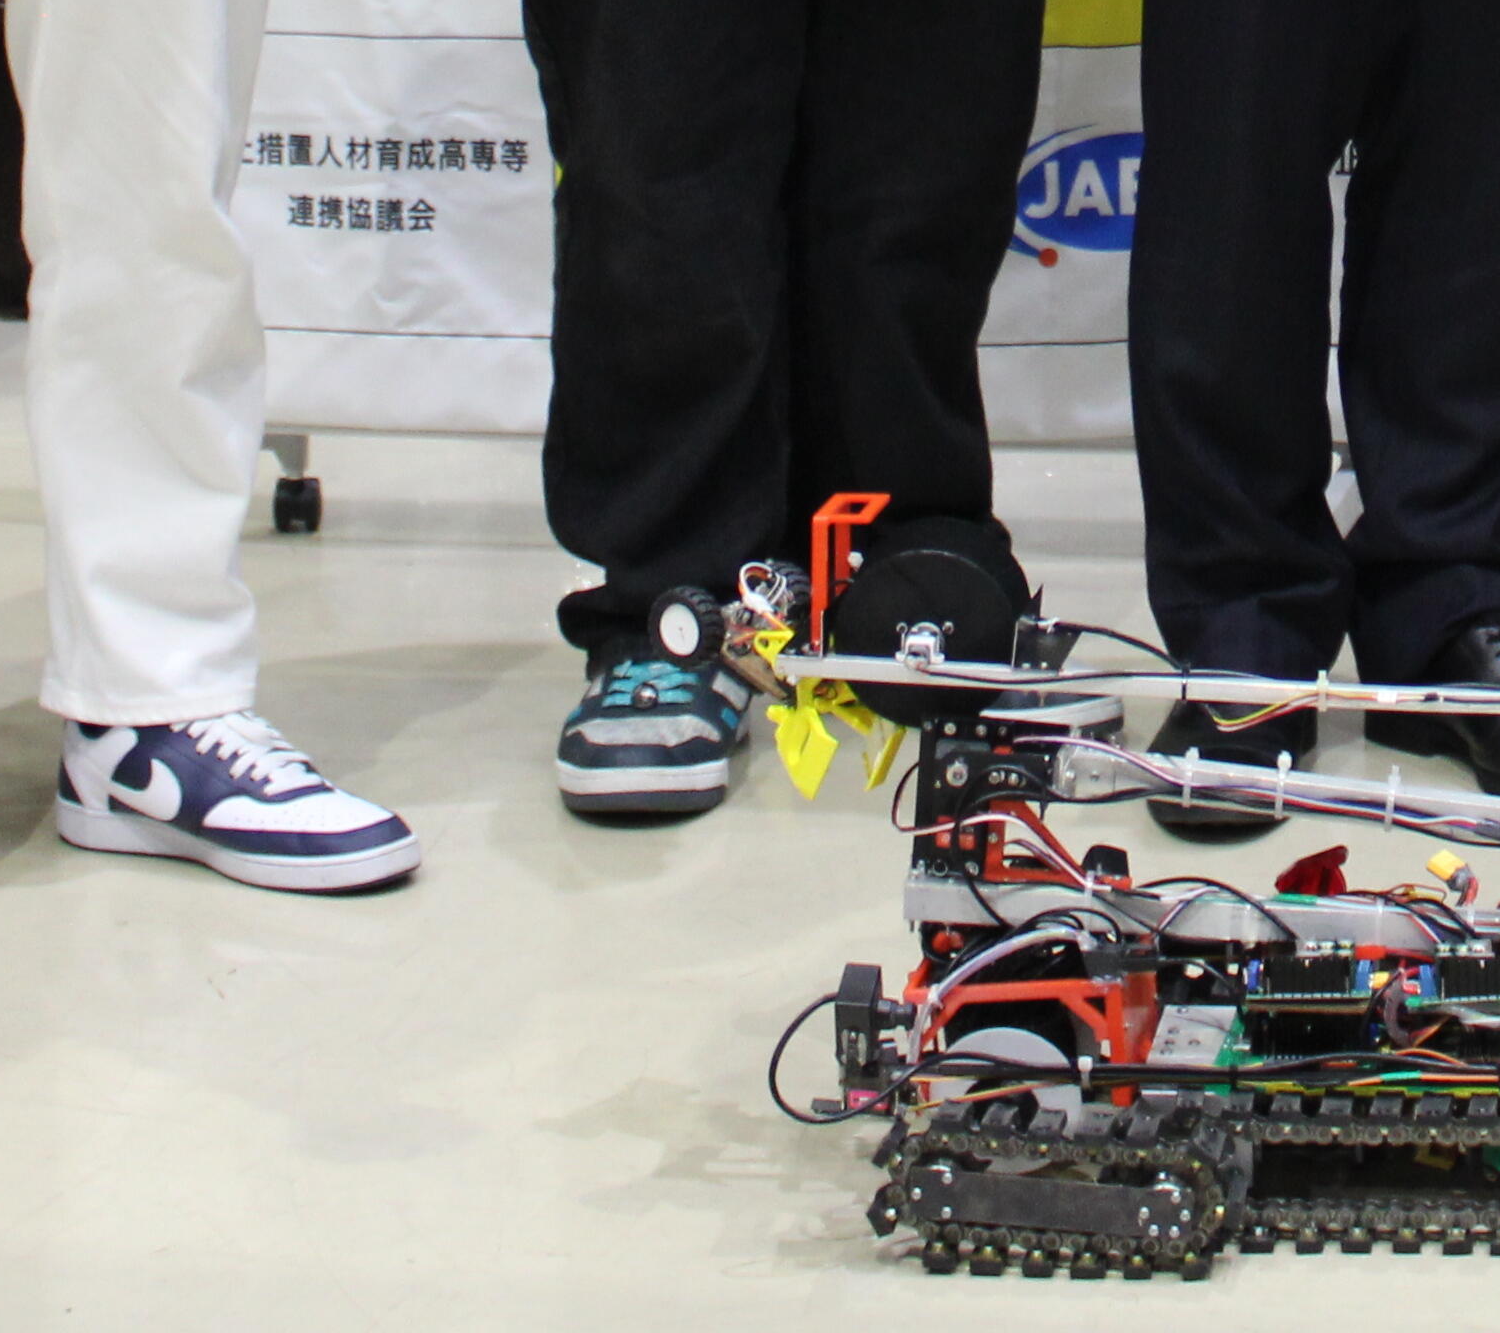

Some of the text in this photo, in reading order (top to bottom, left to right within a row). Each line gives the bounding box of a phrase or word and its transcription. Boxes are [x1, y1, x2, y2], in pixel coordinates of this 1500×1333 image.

[287, 194, 437, 233] 連携協議会
